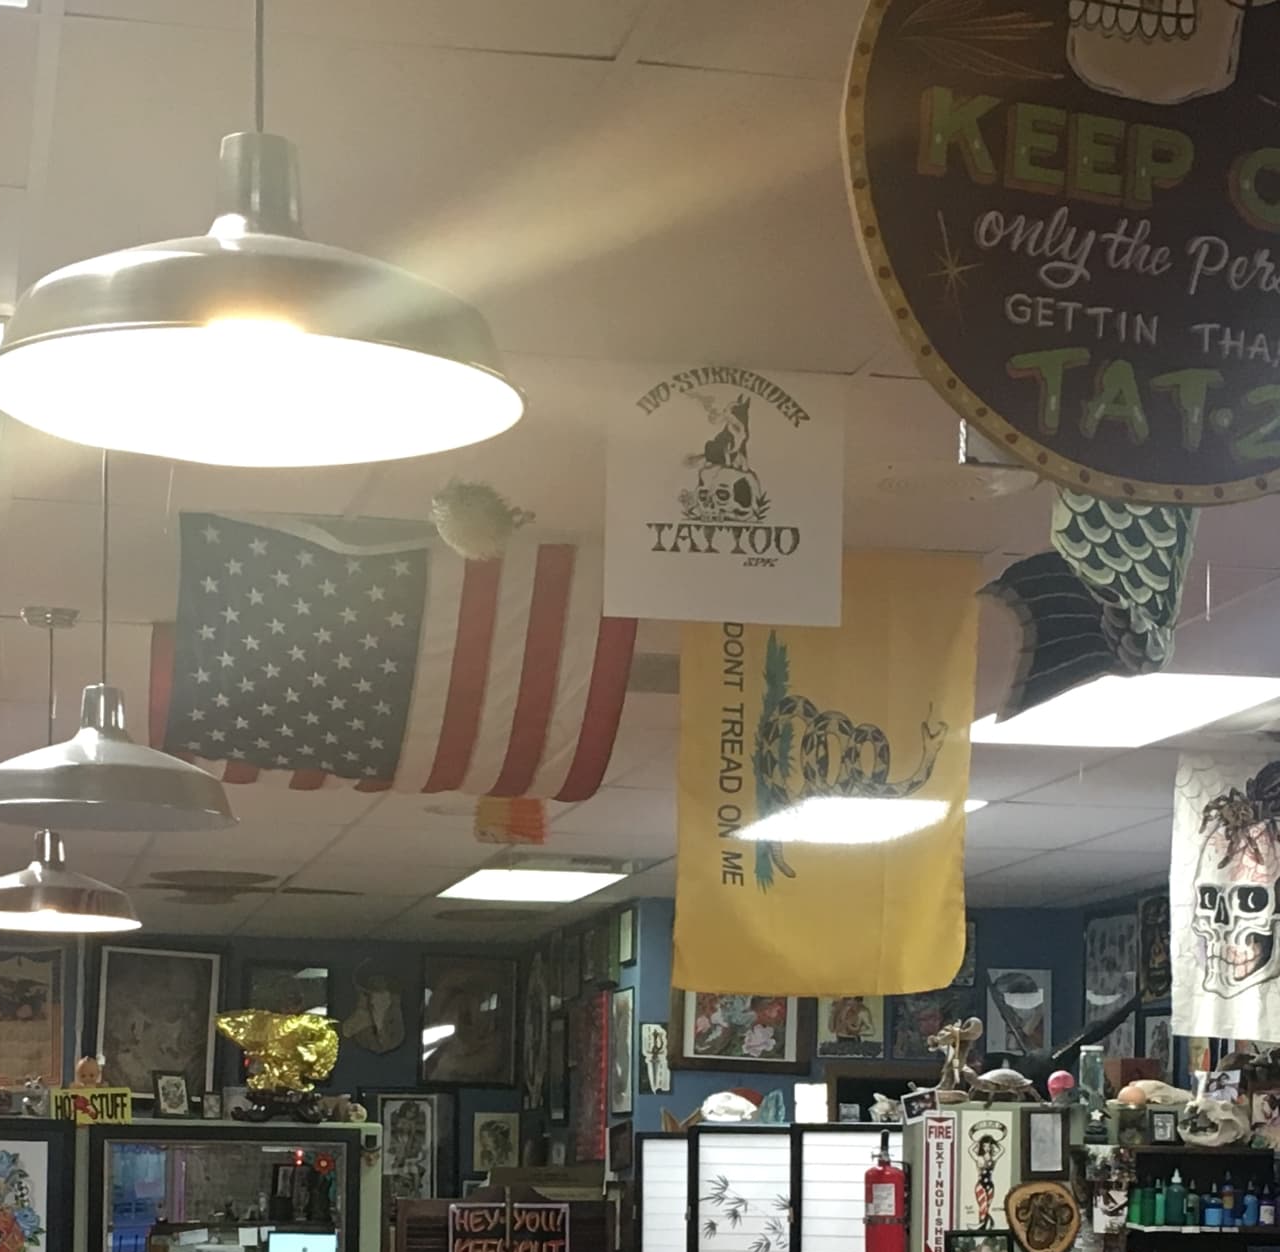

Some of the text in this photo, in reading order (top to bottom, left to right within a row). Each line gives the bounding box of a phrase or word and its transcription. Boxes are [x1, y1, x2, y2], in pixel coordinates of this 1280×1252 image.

[917, 84, 1195, 209] KEEP
[975, 206, 1096, 289] only
[1096, 216, 1173, 276] the
[1004, 293, 1160, 346] GETTIN
[646, 522, 801, 556] TATTOO
[717, 622, 744, 887] DONT TREAD ON ME
[90, 1093, 127, 1120] STUFF
[928, 1125, 952, 1140] FIRE
